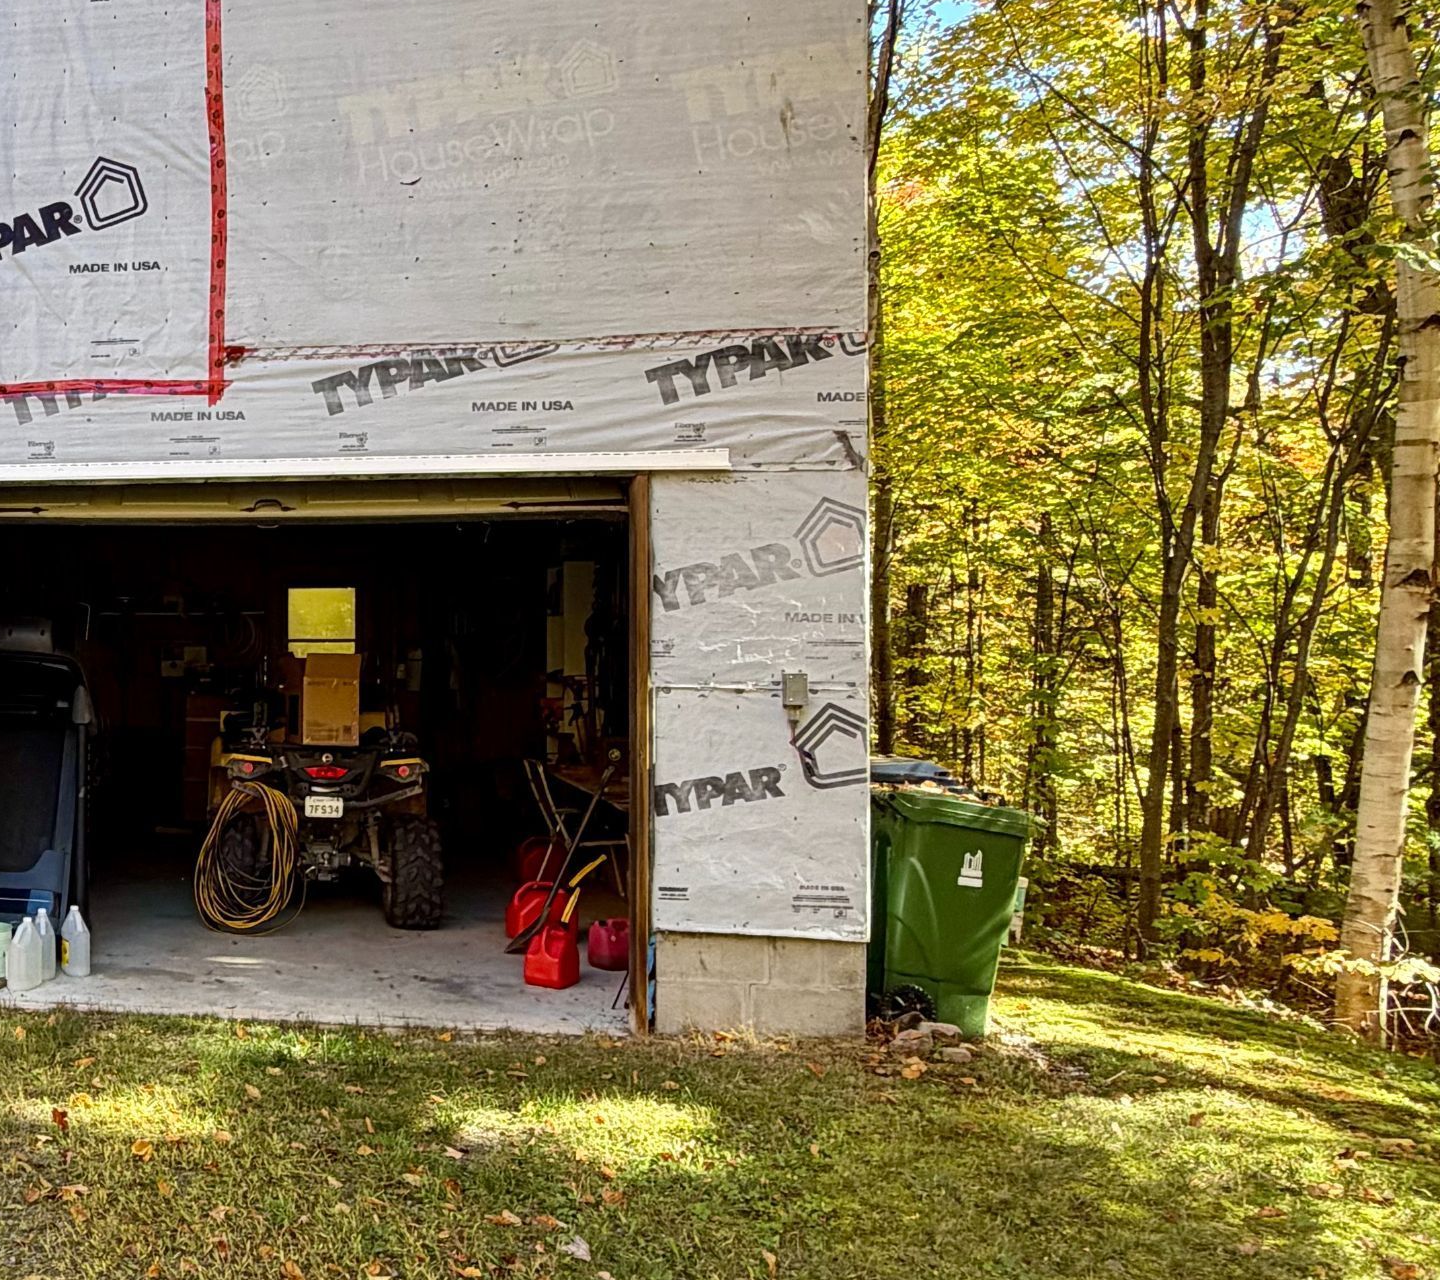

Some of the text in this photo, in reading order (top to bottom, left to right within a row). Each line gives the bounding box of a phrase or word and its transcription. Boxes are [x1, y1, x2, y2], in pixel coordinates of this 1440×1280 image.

[69, 261, 161, 274] MADE IN USA
[817, 392, 865, 403] MADE
[472, 401, 574, 412] MADE IN USA
[151, 411, 246, 422] MADE IN USA
[653, 543, 801, 613] YPAR
[785, 612, 855, 624] MADE IN
